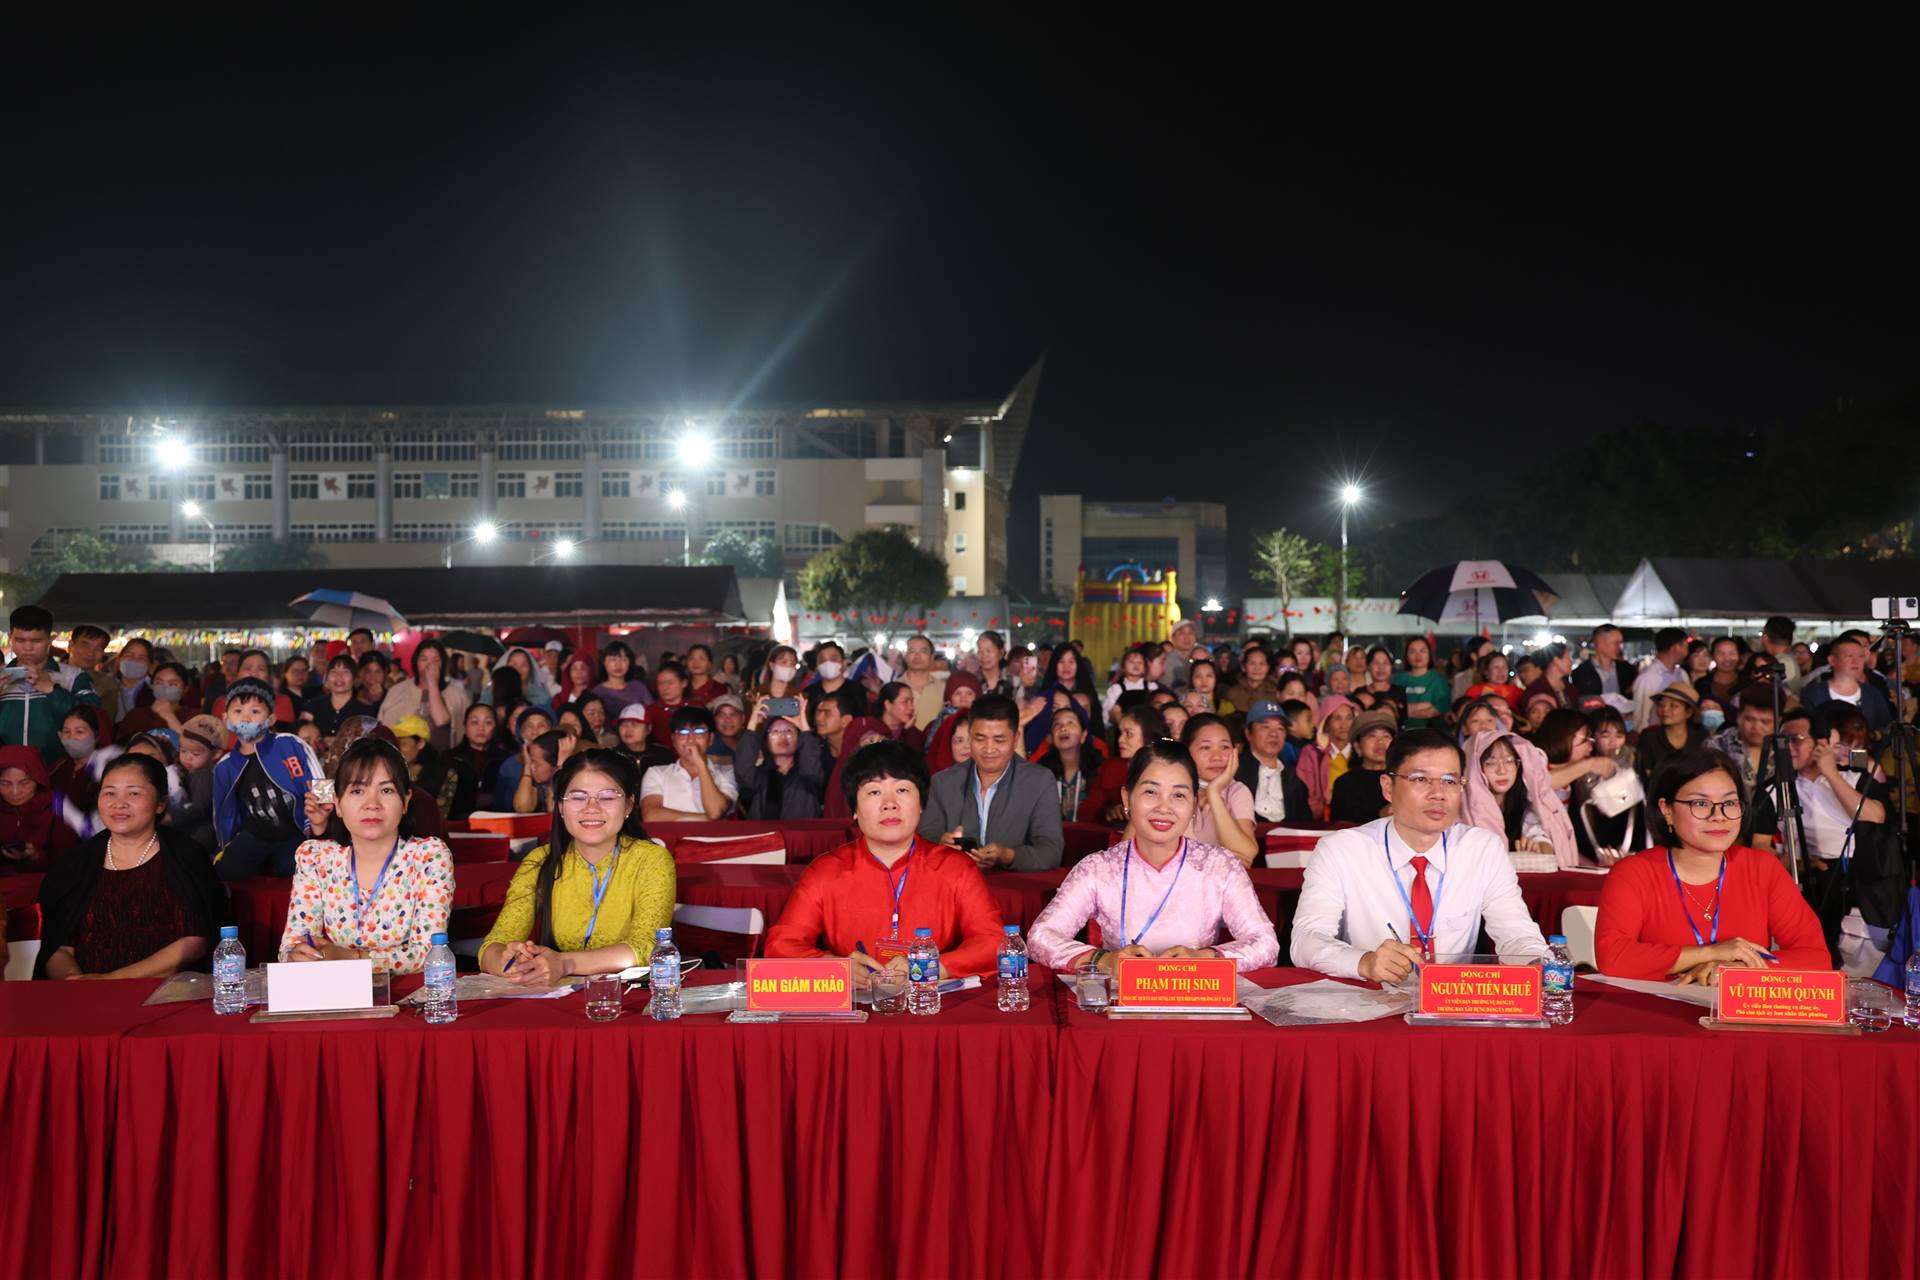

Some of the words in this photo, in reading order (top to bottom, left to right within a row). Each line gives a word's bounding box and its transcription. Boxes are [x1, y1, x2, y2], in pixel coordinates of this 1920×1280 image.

[1182, 964, 1197, 972] CHÍ
[753, 979, 777, 992] BAN
[780, 976, 810, 992] GIÁM
[814, 974, 844, 992] KHẢO
[1136, 978, 1168, 992] PHẠM
[1171, 978, 1191, 993] THỊ
[1193, 978, 1220, 990] SINH
[1544, 973, 1564, 983] aVie
[1761, 975, 1785, 983] ĐỒNG
[1787, 975, 1802, 983] CHÍ
[1476, 980, 1500, 995] TIẾN
[1503, 980, 1532, 996] KHUÊ
[1729, 984, 1744, 997] VŨ
[1747, 986, 1766, 1001] THỊ
[1769, 987, 1791, 999] KIM
[1794, 985, 1834, 1001] QUỲNH
